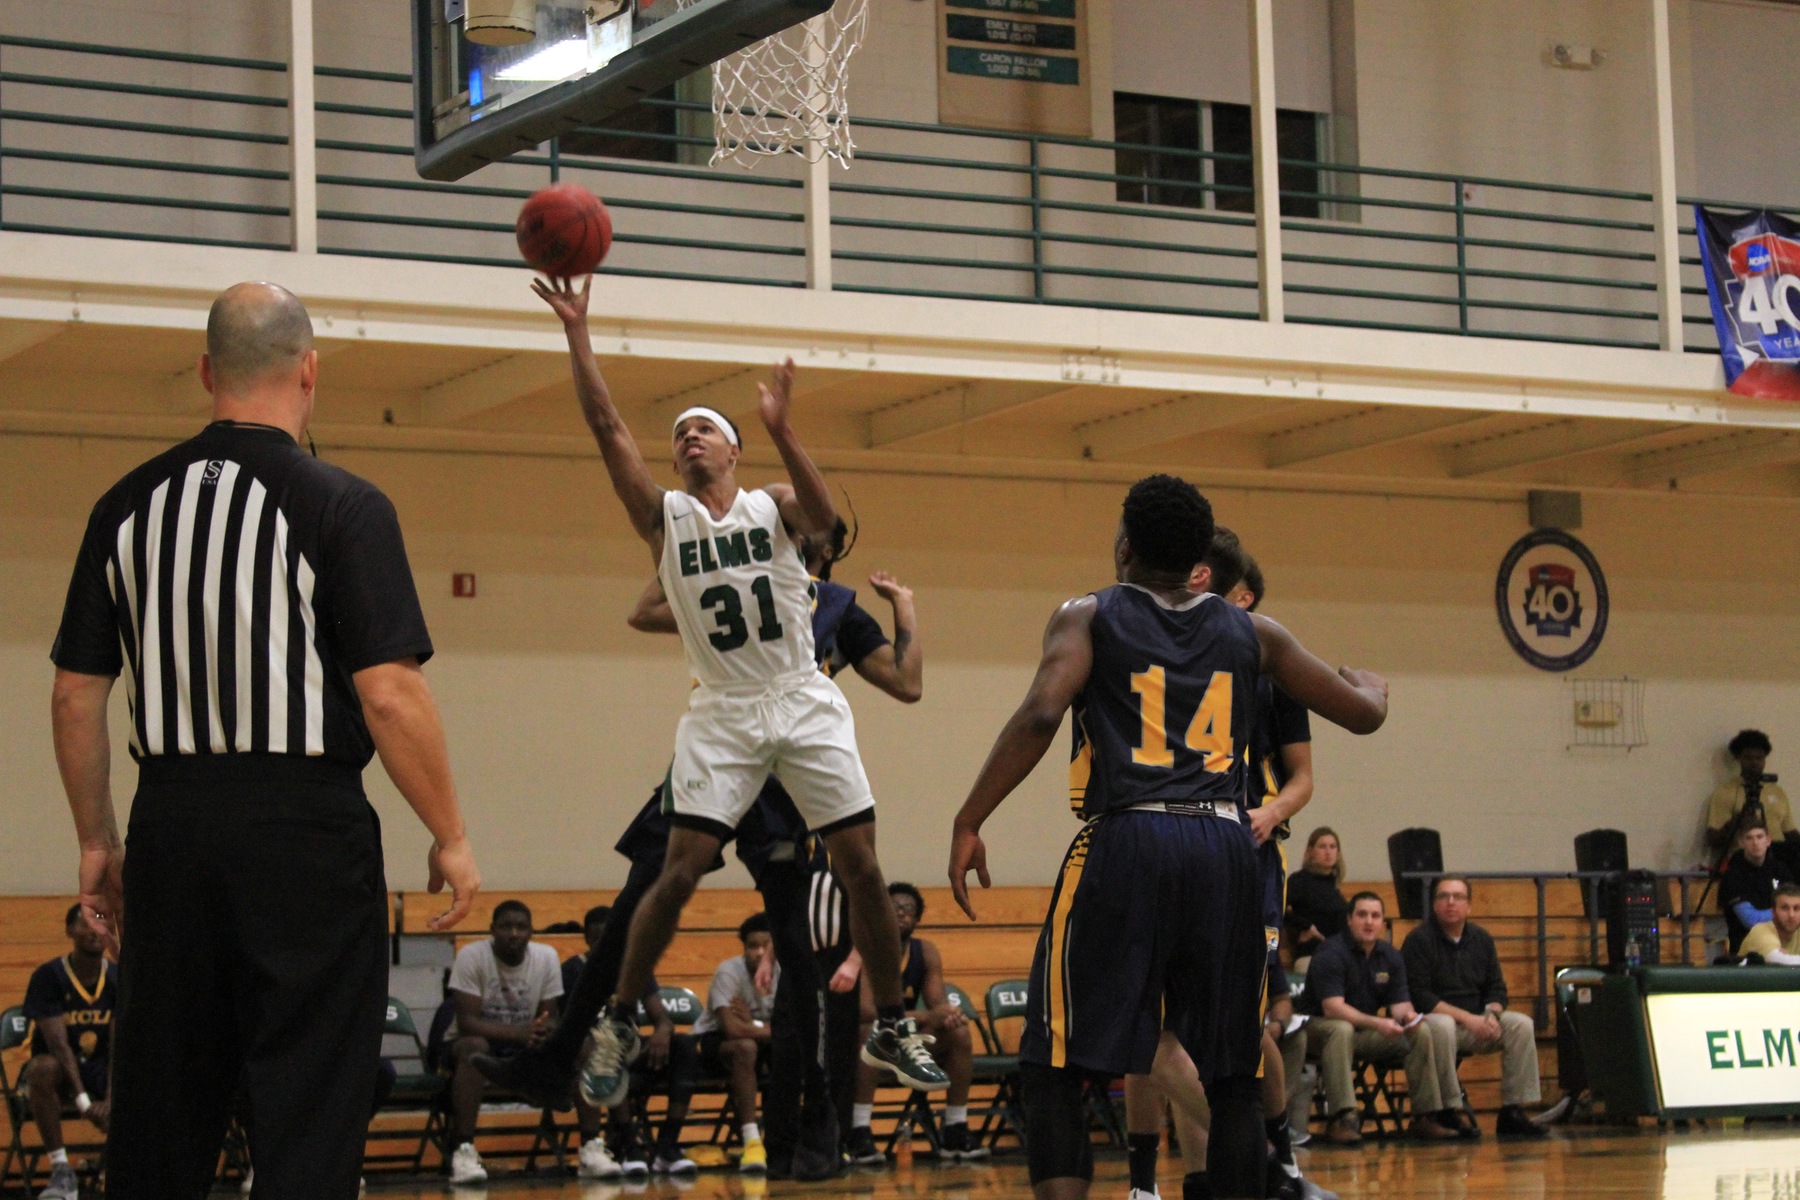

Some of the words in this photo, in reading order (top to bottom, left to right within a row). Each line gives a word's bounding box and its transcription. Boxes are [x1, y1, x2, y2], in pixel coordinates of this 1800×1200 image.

[1739, 274, 1800, 335] 40
[679, 527, 773, 577] ELMS
[699, 575, 783, 652] 31
[1529, 584, 1574, 621] 40
[1130, 664, 1234, 775] 14
[1706, 1028, 1800, 1070] ELM
